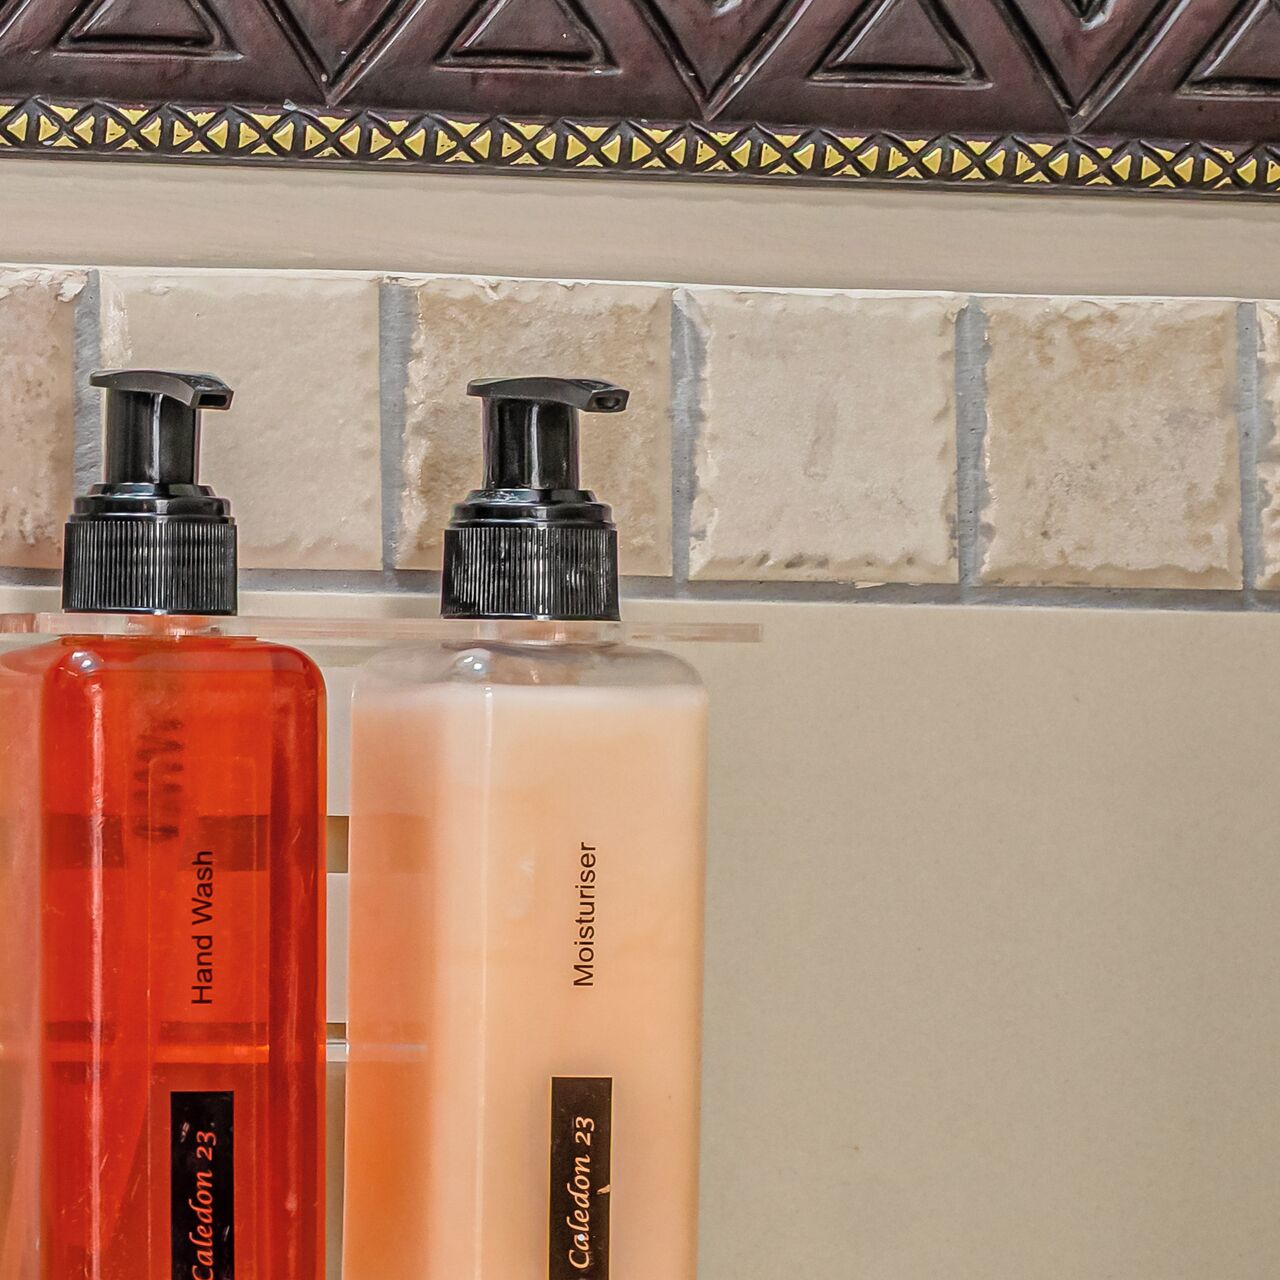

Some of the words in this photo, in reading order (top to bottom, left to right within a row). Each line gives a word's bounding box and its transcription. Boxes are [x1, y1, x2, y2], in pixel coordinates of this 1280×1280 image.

[191, 850, 214, 926] Wash
[572, 841, 597, 987] Moisturiser
[191, 935, 214, 1004] Hand
[195, 1129, 217, 1162] 23
[574, 1115, 596, 1147] 23
[566, 1153, 591, 1270] Caledon
